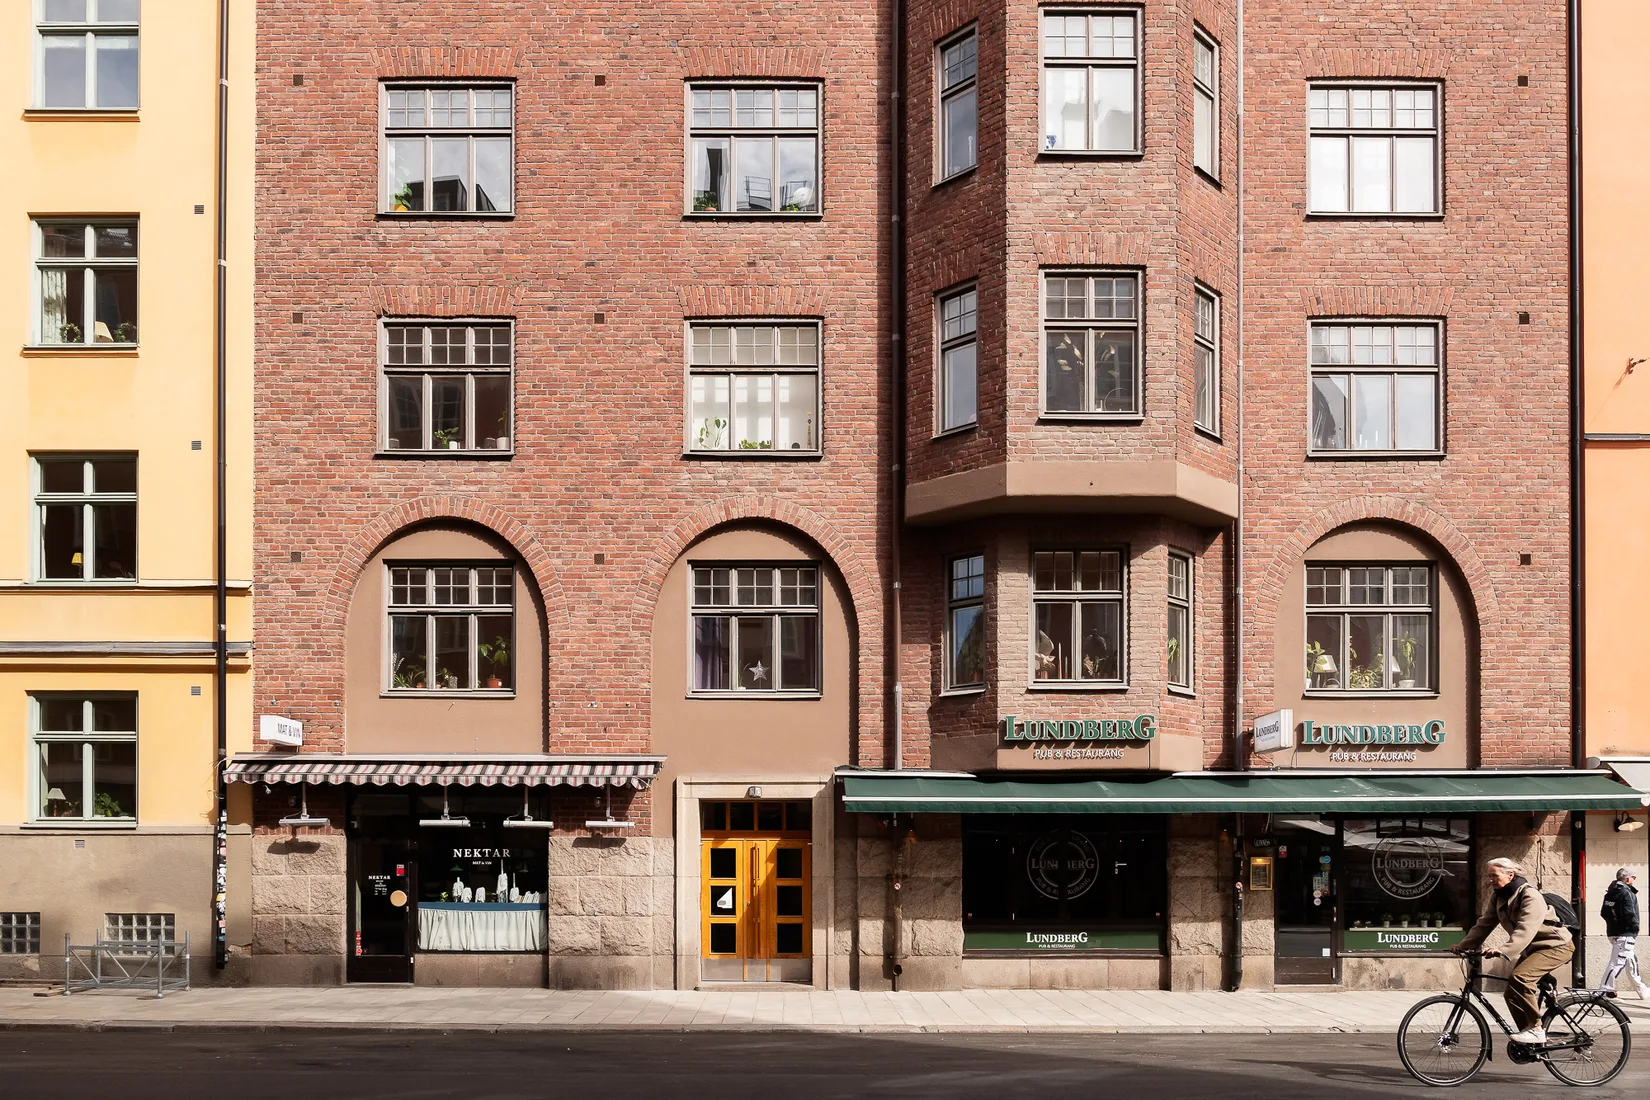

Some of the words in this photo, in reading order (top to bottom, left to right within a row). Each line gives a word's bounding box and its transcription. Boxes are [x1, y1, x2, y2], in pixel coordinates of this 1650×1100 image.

[277, 723, 288, 735] MAT
[1005, 714, 1156, 740] LUNDBERG
[1256, 720, 1279, 738] LUNDBERG
[1302, 719, 1446, 745] LUNDBERG
[1036, 749, 1053, 758] PUB
[1055, 749, 1063, 758] &
[1066, 749, 1125, 758] RESTAURANG
[1332, 752, 1349, 761] PUB
[1351, 752, 1359, 761] &
[1361, 752, 1417, 761] RESTAURANG
[453, 848, 511, 858] NEKTAR
[1376, 857, 1439, 869] LUNDBERG
[1380, 876, 1393, 889] PUB
[1397, 876, 1436, 896] RESTAURANG
[1026, 931, 1088, 943] LUNDBERG
[1377, 932, 1439, 943] LUNDBERG
